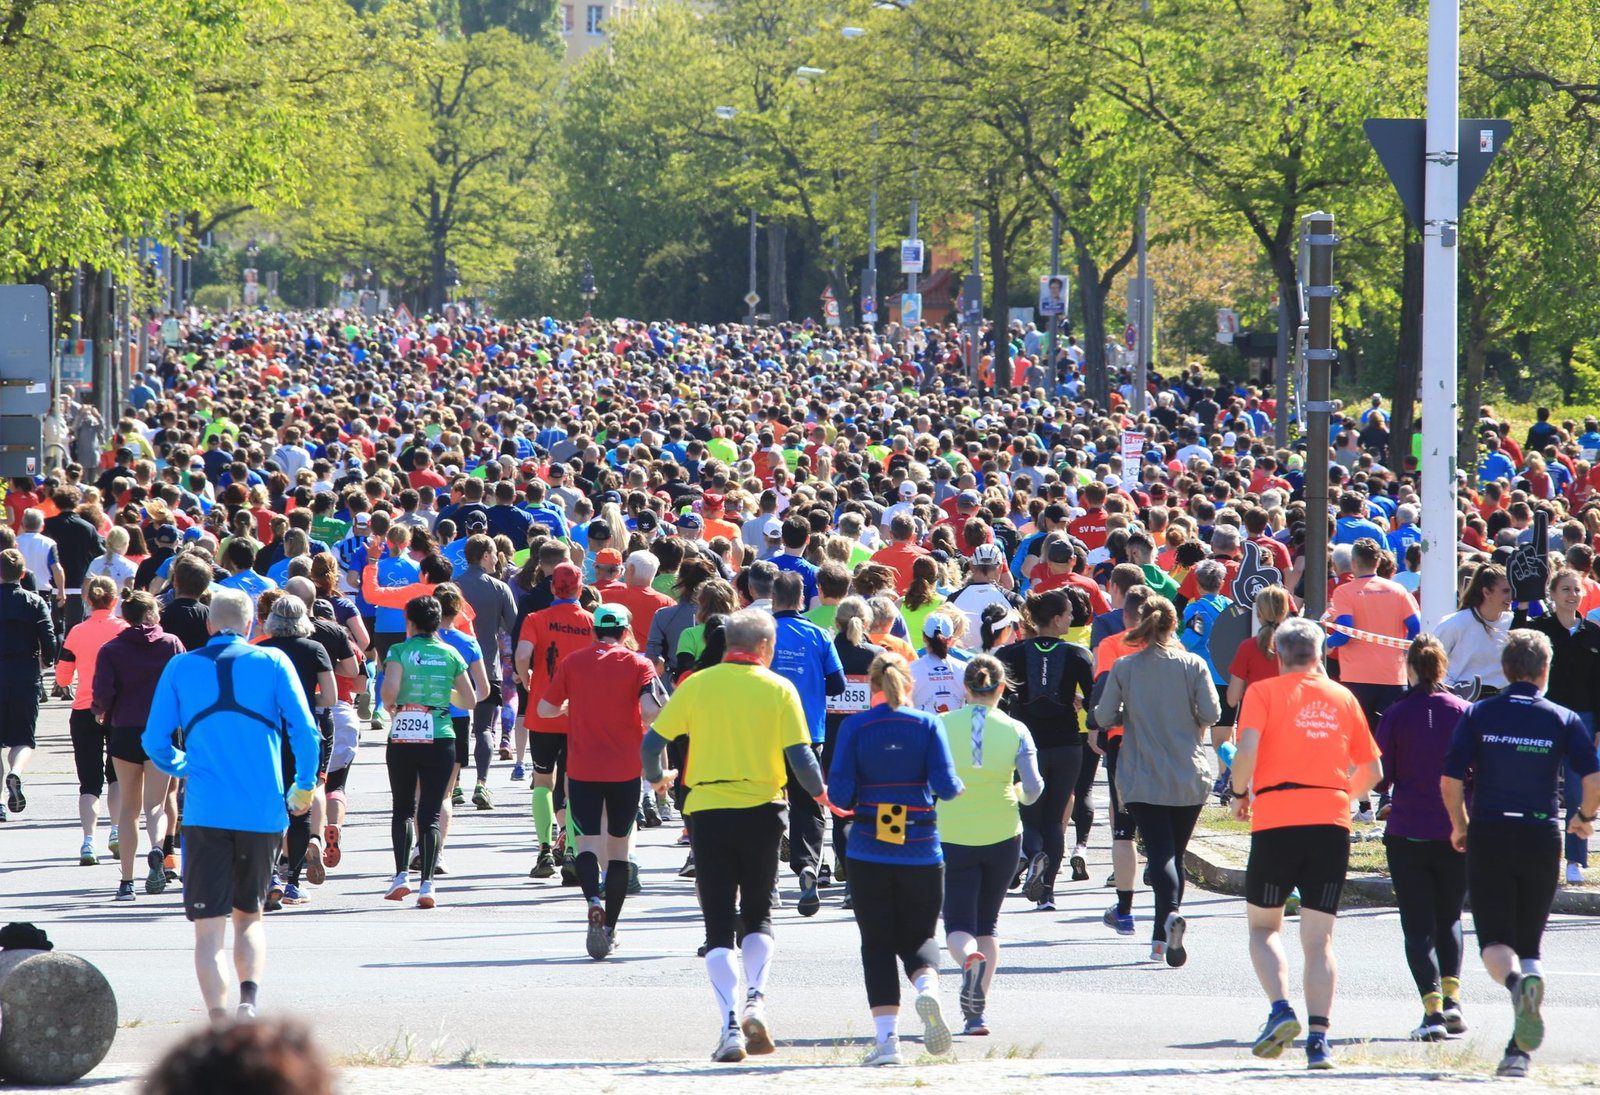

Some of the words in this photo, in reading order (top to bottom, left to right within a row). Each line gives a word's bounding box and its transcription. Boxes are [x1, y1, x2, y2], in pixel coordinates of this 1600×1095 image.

[549, 622, 591, 636] Michael
[395, 718, 429, 731] 25294
[1306, 730, 1329, 739] Berlin
[1482, 734, 1553, 748] TRI-FINISHER
[1516, 745, 1549, 754] BERLIN
